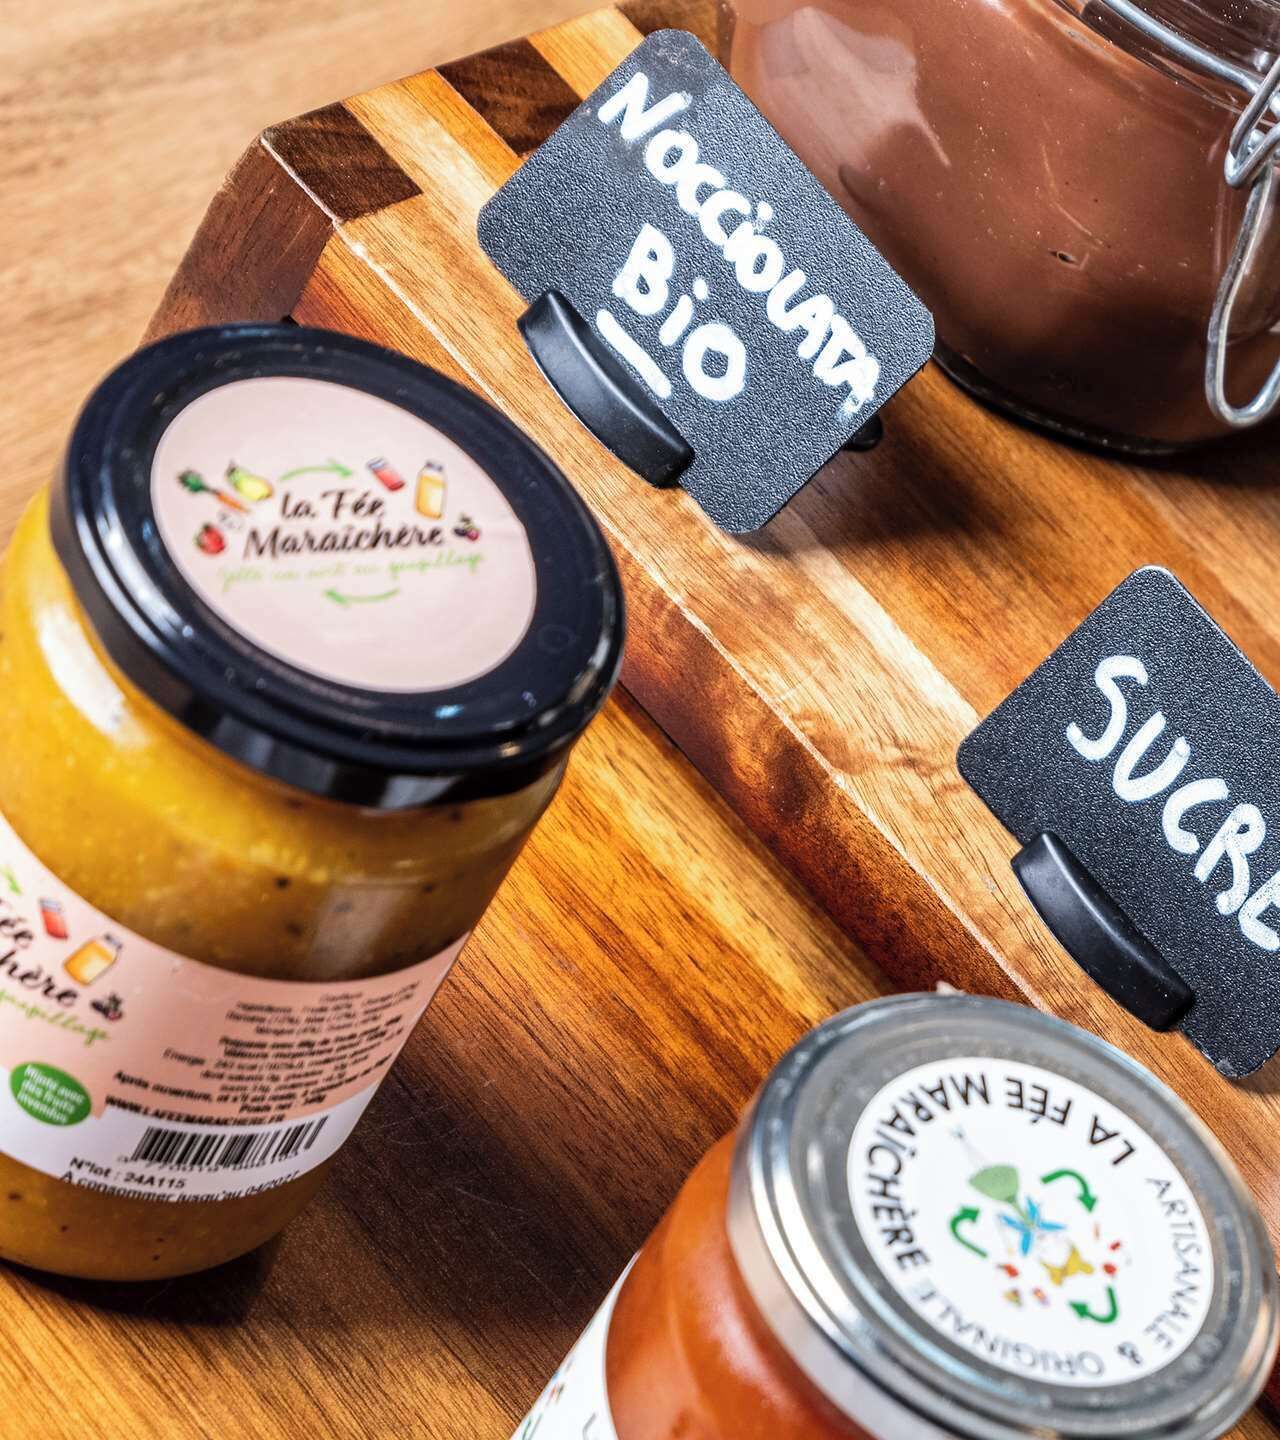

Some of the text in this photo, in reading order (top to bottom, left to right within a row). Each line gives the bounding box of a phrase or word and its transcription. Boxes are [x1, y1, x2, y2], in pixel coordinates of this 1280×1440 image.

[123, 1171, 187, 1190] 24A115
[866, 1072, 1136, 1273] LA FÉE MARAÎCHÈRE
[1145, 1175, 1203, 1350] ARTISANALE
